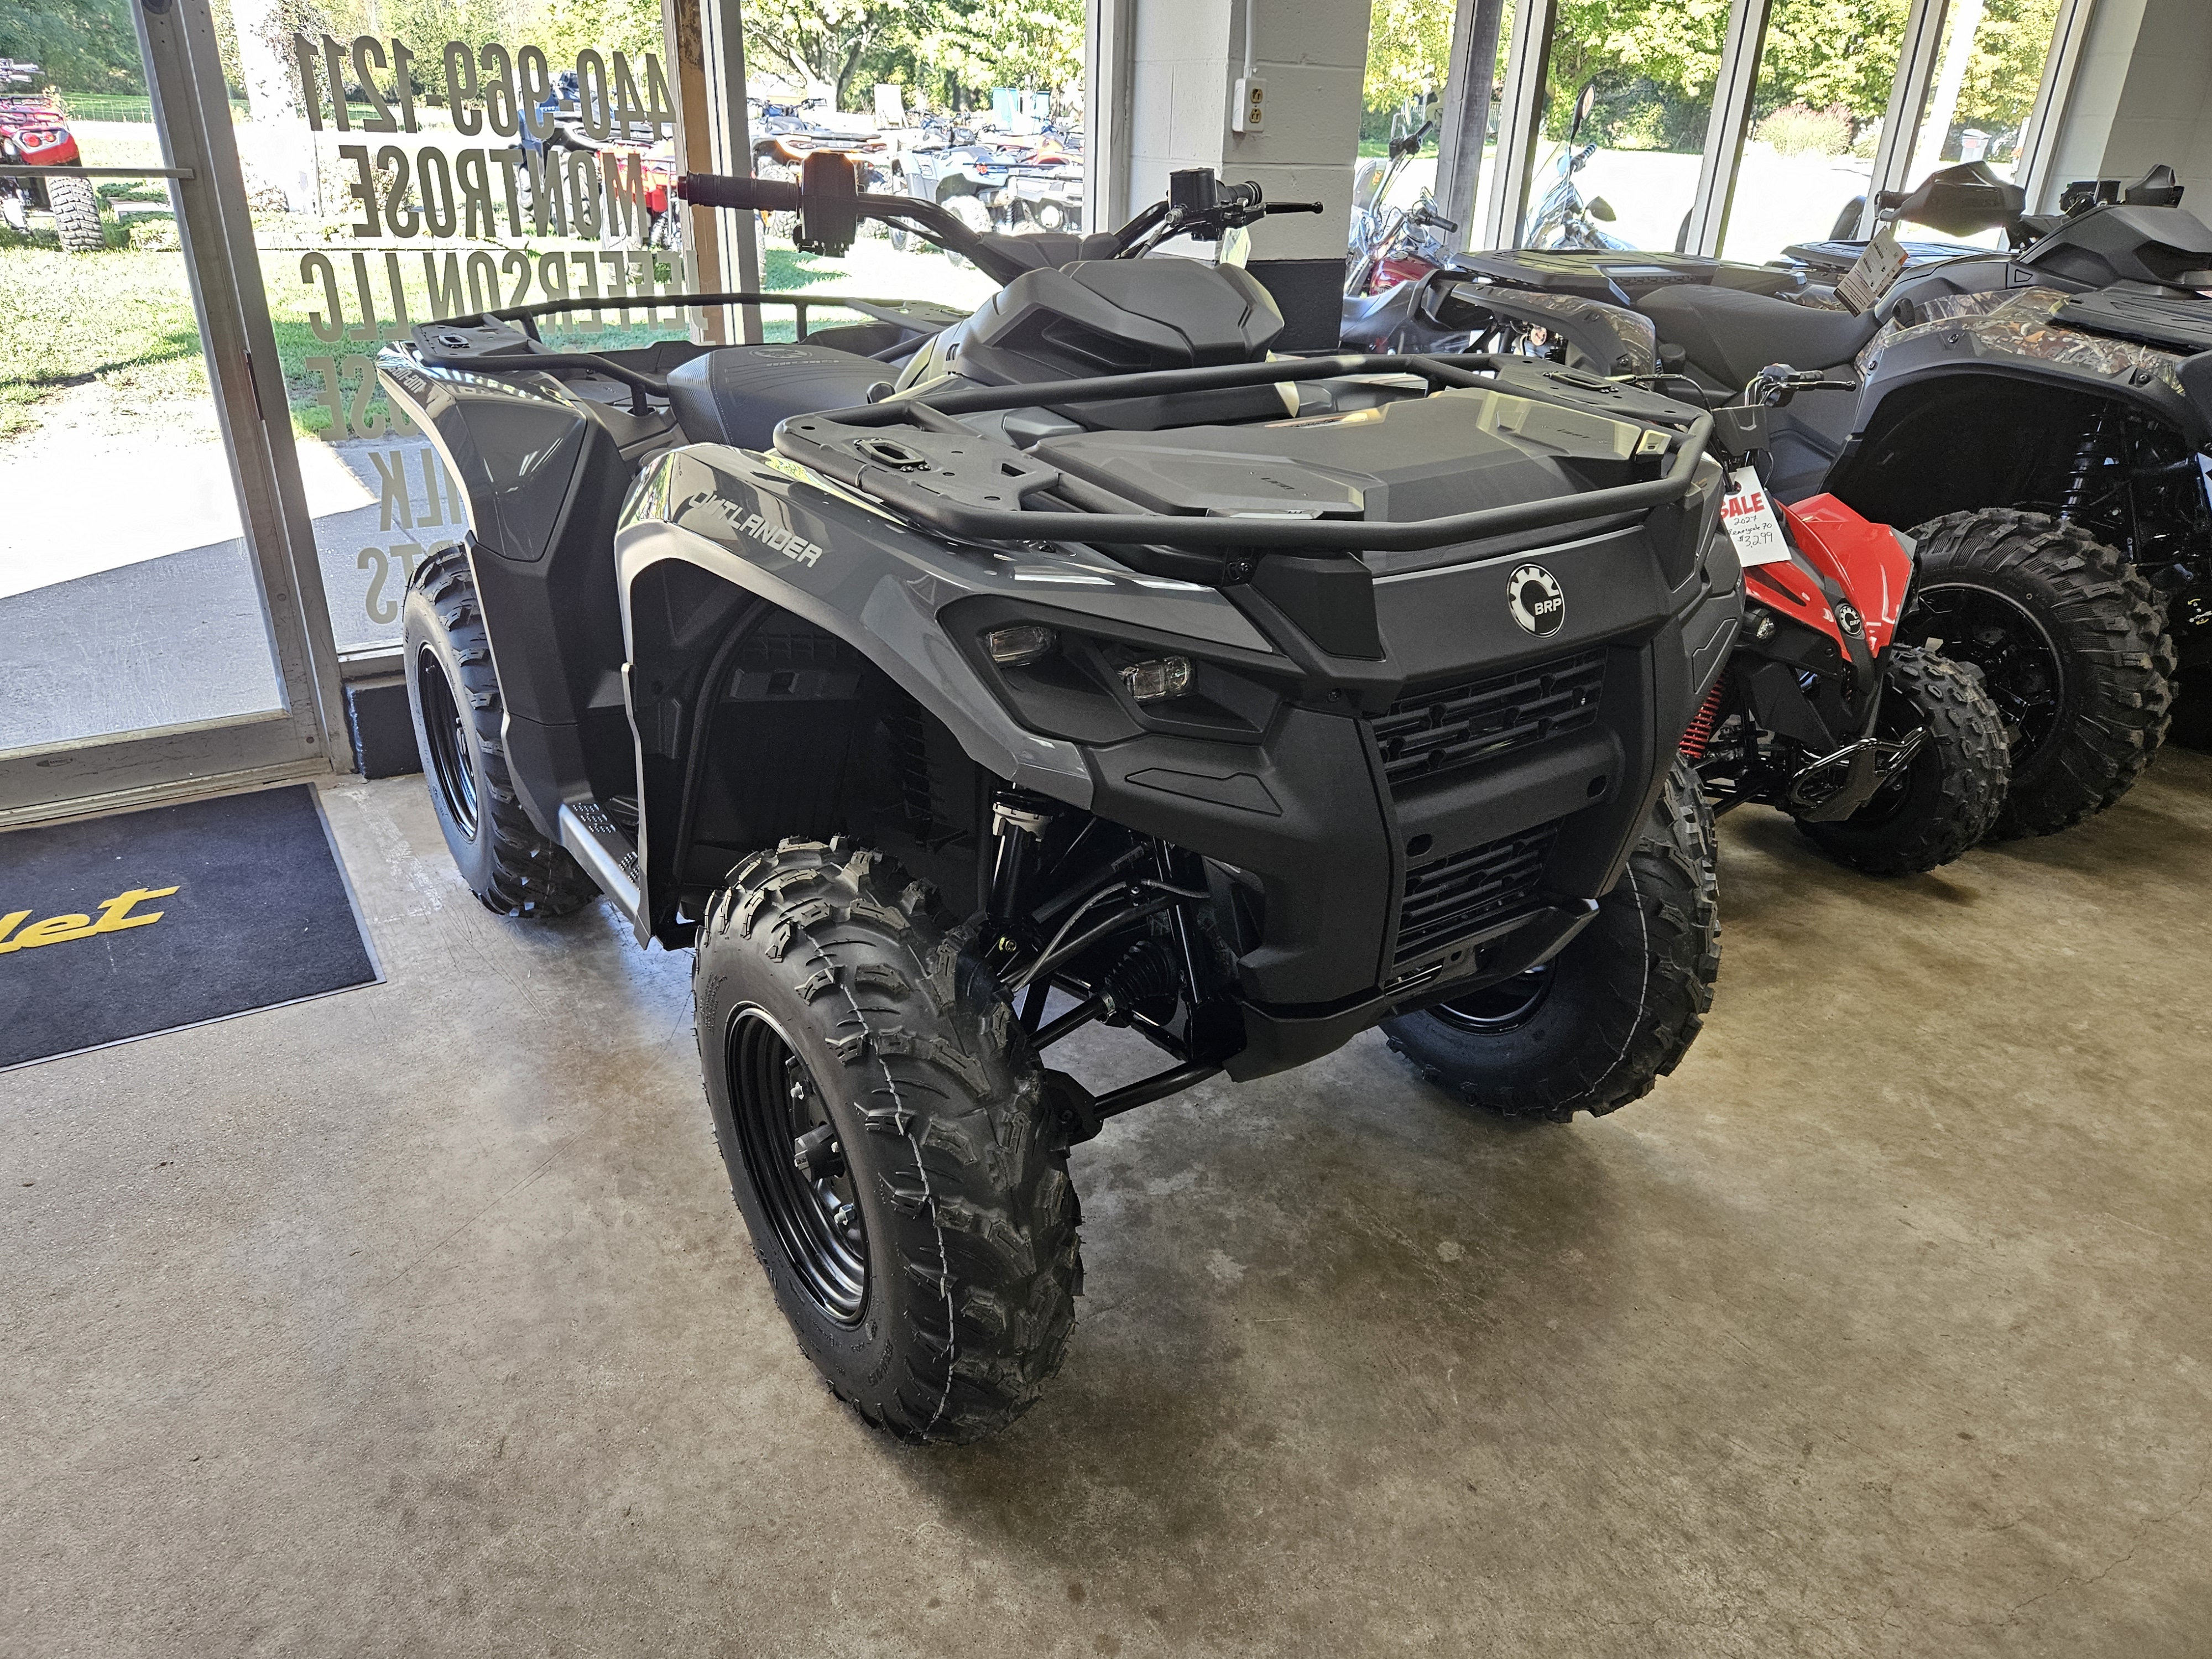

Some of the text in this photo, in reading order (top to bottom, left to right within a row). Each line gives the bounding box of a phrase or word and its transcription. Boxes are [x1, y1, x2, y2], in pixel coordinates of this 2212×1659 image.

[1720, 492, 1765, 519] SALE
[688, 488, 823, 568] OUTLANDER
[1534, 598, 1562, 615] BRP
